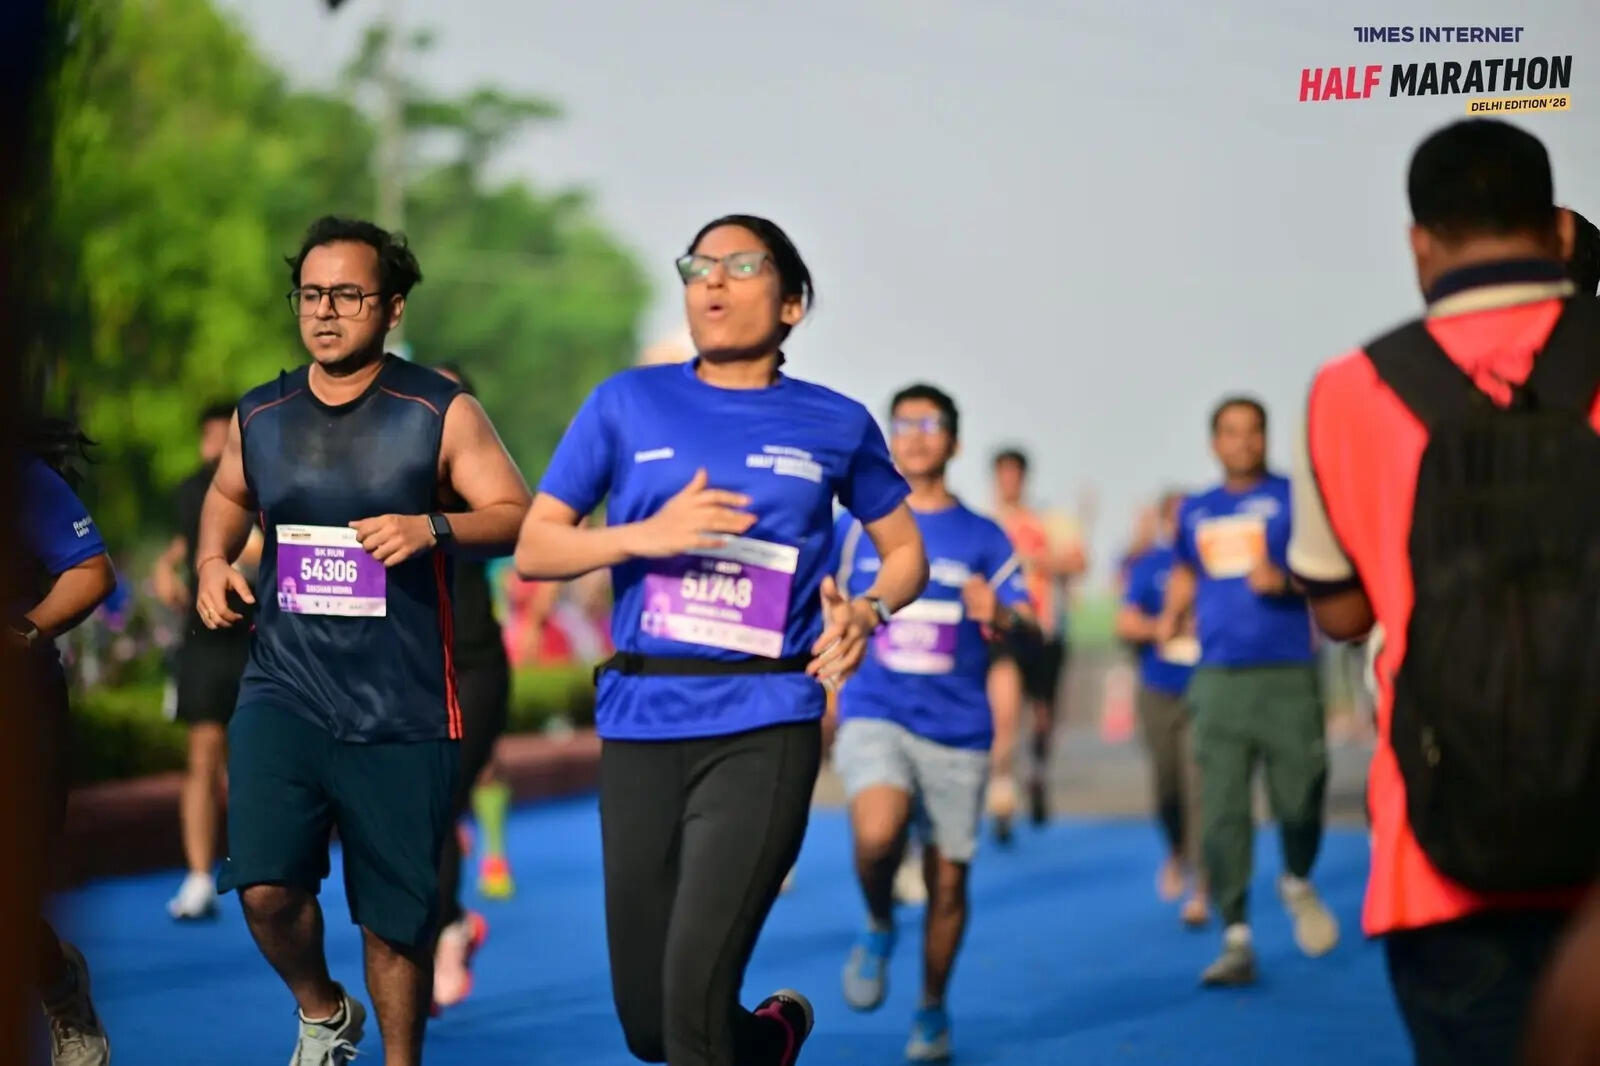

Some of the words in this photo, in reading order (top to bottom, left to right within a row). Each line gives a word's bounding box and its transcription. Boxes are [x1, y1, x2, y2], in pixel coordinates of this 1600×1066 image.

[327, 548, 345, 558] RUN
[301, 558, 357, 583] 54306
[680, 570, 753, 608] 51748
